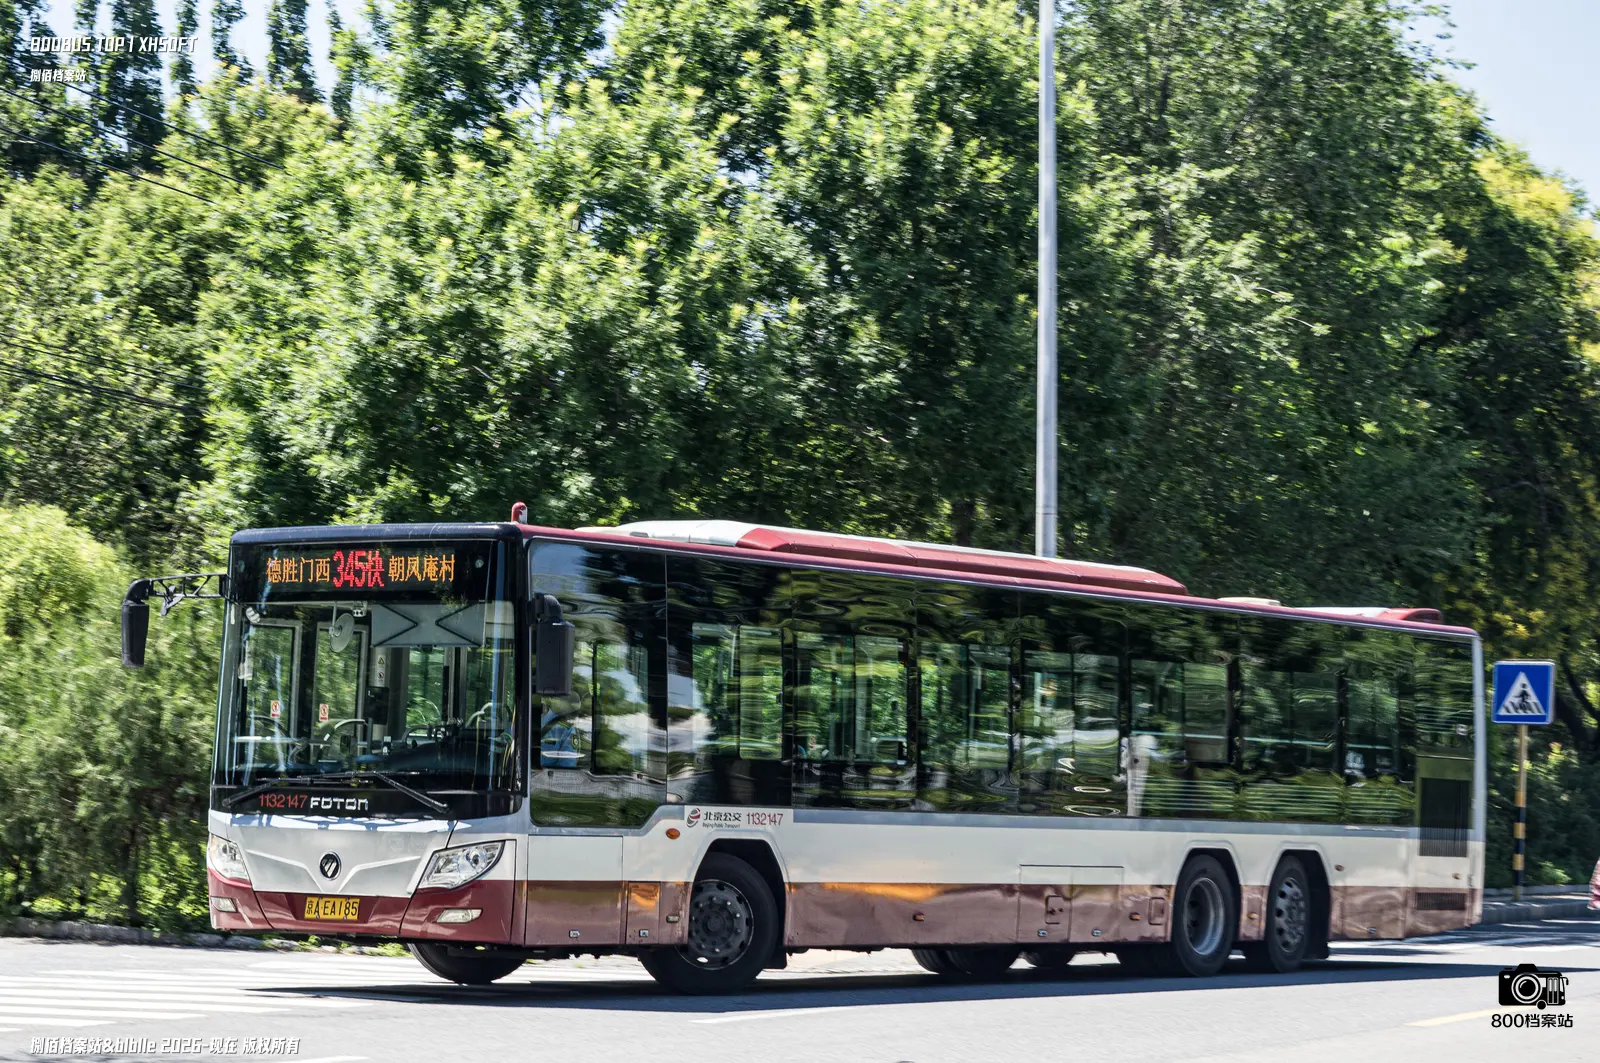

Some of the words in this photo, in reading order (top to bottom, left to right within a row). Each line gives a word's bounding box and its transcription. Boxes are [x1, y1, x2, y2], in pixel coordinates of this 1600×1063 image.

[266, 556, 331, 583] 德胜门西
[333, 550, 385, 588] 345快
[388, 554, 456, 582] 朝凤庵村
[259, 793, 308, 809] 1132147
[310, 796, 369, 811] FOTON
[703, 811, 742, 822] 北京公交
[746, 812, 783, 826] 1132147
